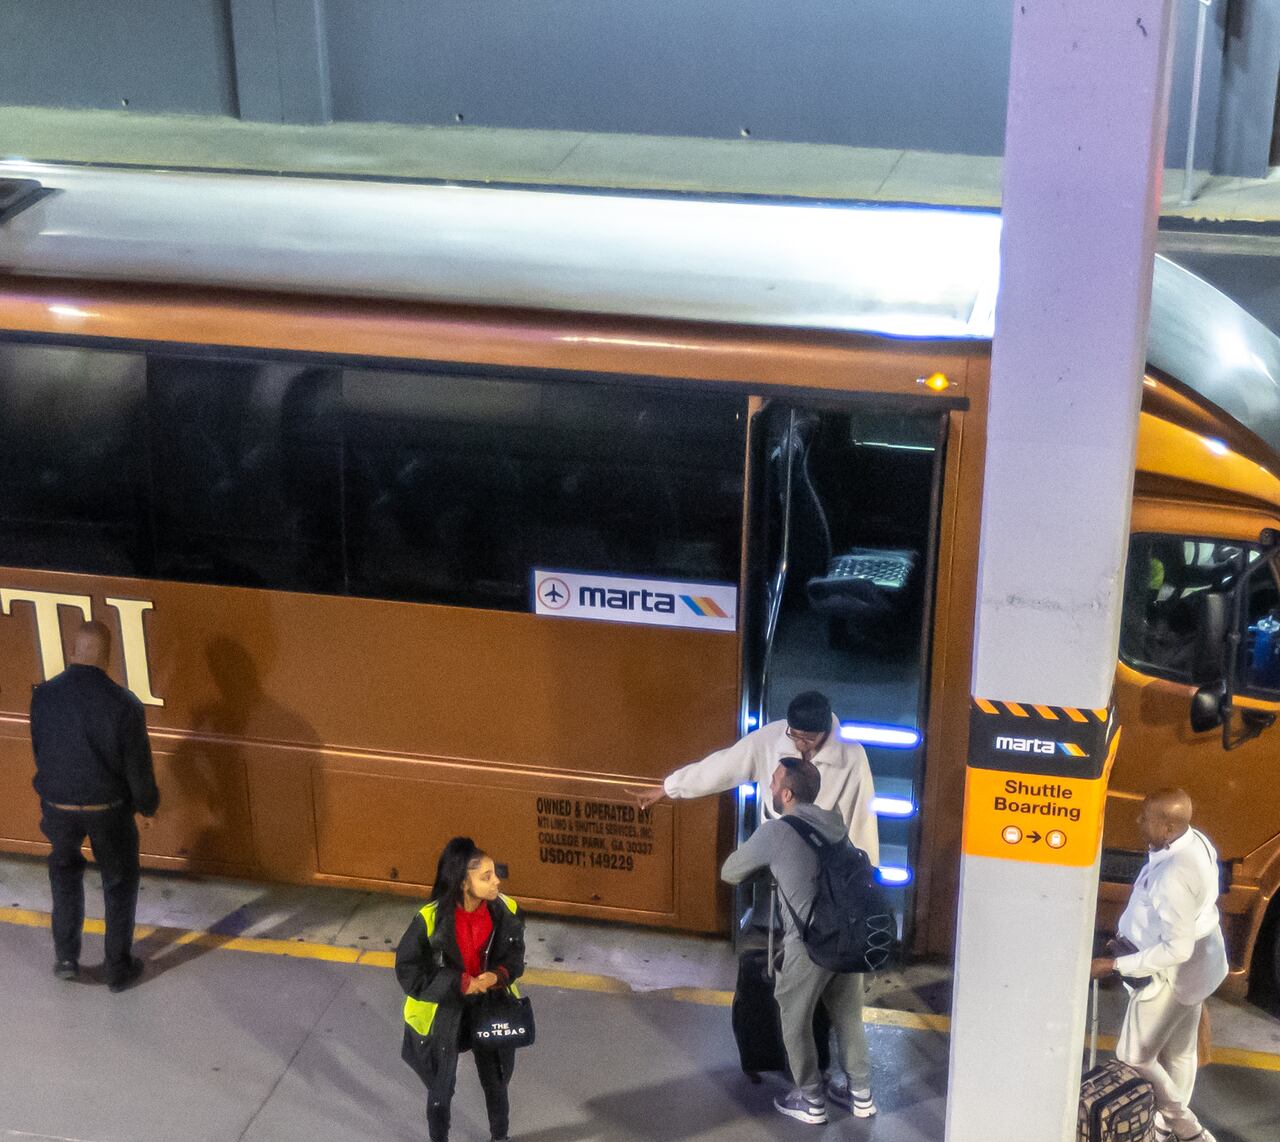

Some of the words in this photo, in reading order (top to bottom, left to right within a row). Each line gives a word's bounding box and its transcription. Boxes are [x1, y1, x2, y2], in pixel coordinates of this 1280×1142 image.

[579, 586, 676, 614] marta
[995, 736, 1056, 755] marta
[1004, 779, 1073, 799] Shuttle
[536, 798, 571, 816] OWNED
[584, 802, 635, 822] OPERATED
[993, 796, 1081, 822] Boarding
[538, 831, 579, 847] COLLEGE
[610, 840, 625, 852] GA
[589, 853, 635, 871] 149229
[491, 1022, 510, 1030] THE
